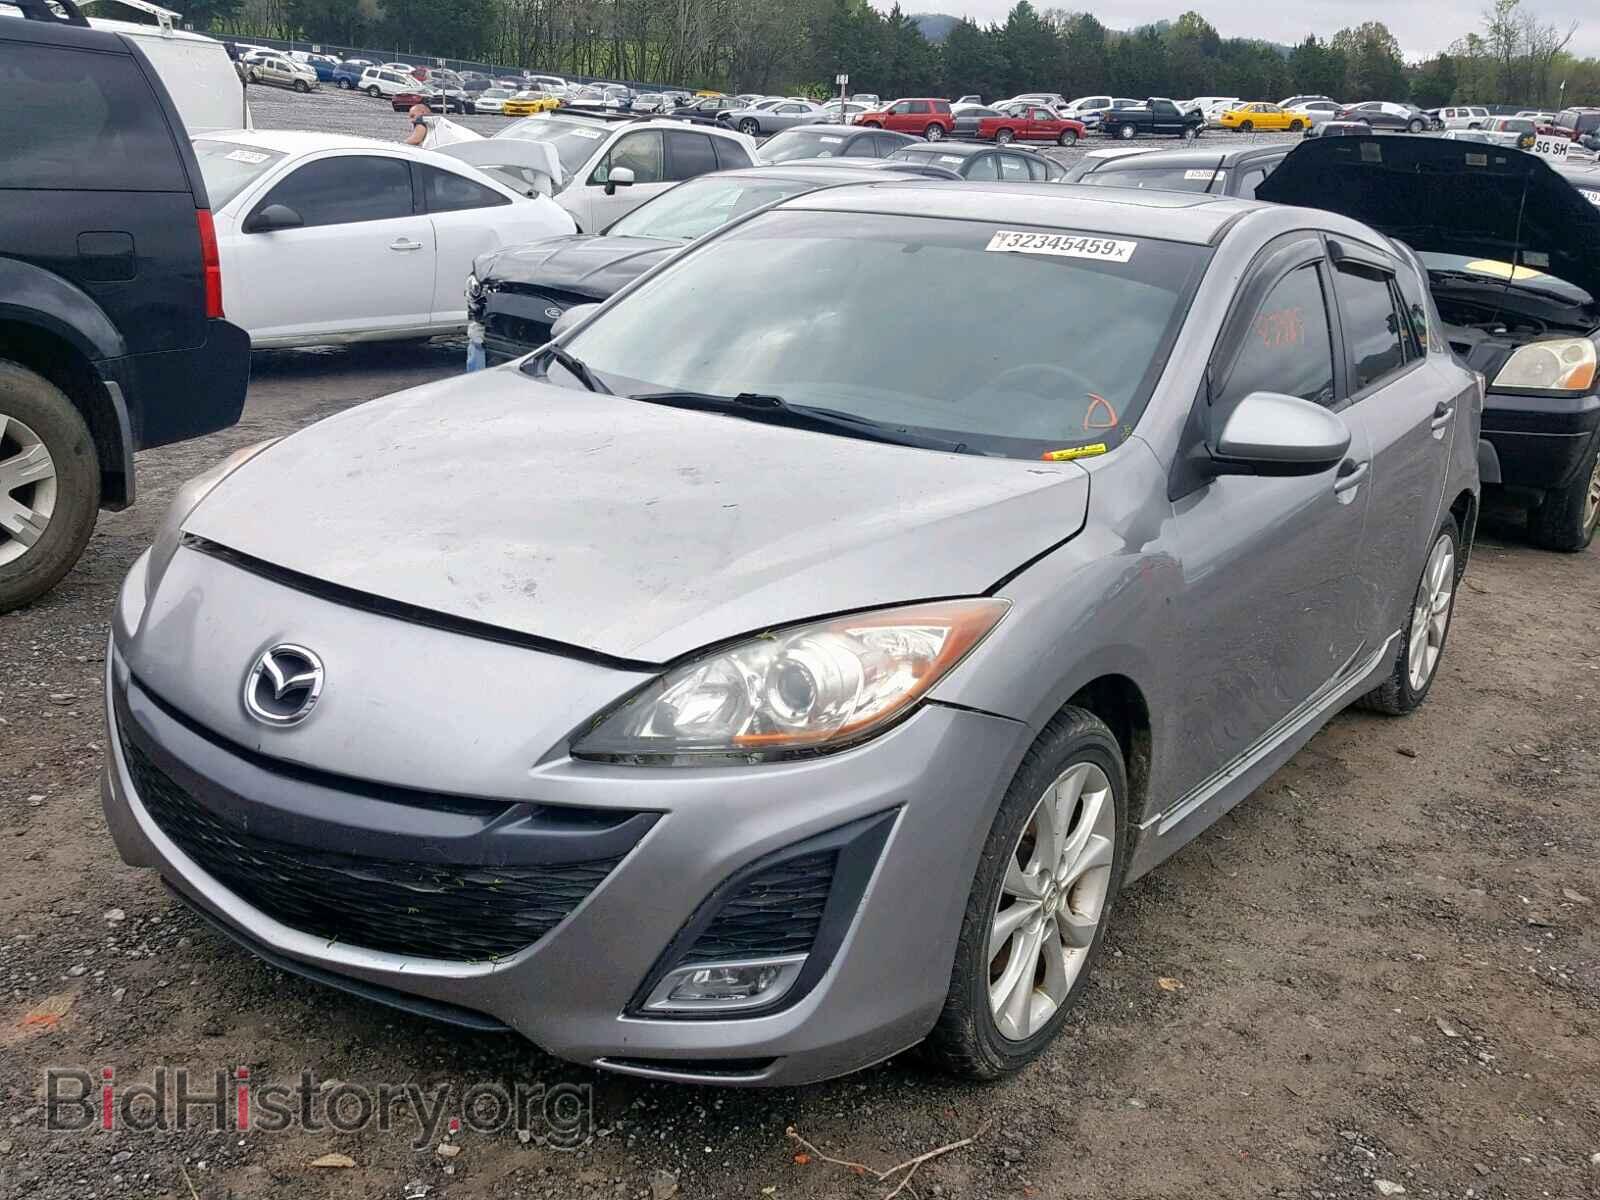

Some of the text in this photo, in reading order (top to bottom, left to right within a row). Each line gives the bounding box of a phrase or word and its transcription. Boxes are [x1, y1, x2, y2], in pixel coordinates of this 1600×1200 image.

[1535, 140, 1568, 155] SG SH
[1007, 233, 1117, 255] 32345459
